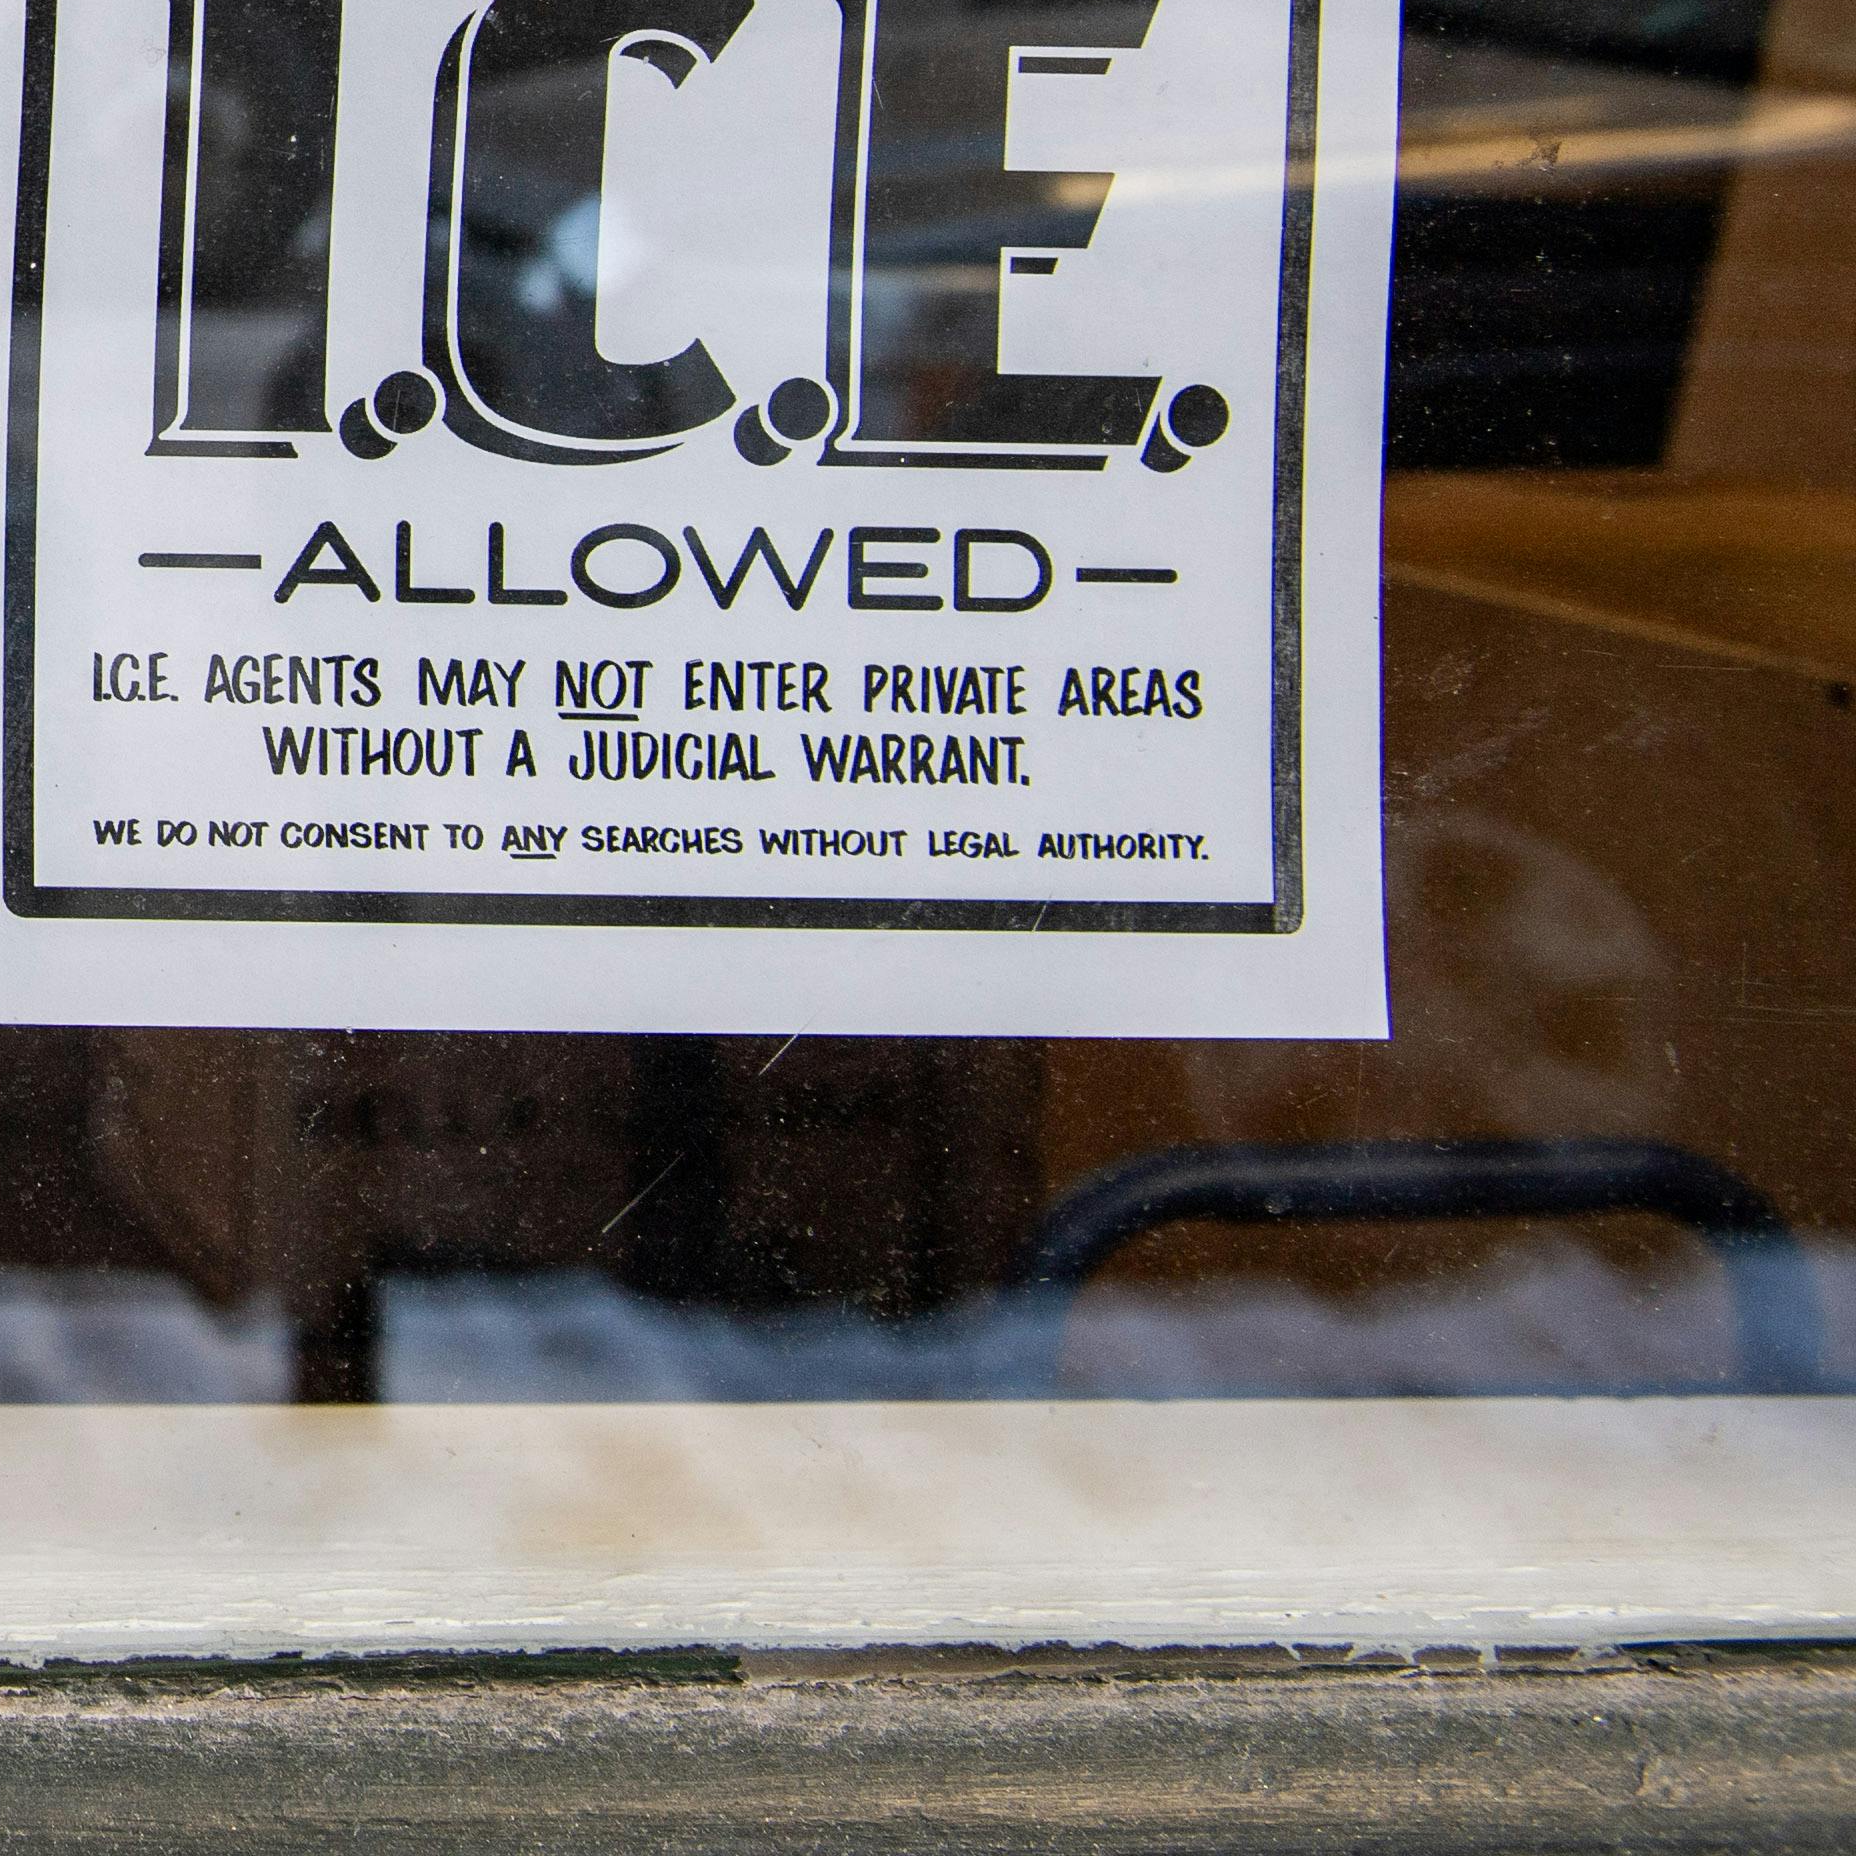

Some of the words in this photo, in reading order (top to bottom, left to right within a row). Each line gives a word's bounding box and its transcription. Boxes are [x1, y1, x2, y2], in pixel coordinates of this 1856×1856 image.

[93, 652, 178, 701] I.C.E.
[205, 654, 381, 707] AGENTS
[419, 657, 525, 707] MAY
[556, 660, 653, 709] NOT
[685, 660, 832, 713] ENTER
[864, 664, 1026, 715] PRIVATE
[1058, 667, 1202, 719] AREAS
[263, 727, 483, 776] WITHOUT
[506, 730, 536, 776] A
[569, 731, 775, 781] JUDICIAL
[801, 734, 1029, 785] WARRANT.
[93, 819, 141, 845] WE
[158, 820, 197, 847] DO
[209, 821, 268, 847] NOT
[281, 822, 429, 850] CONSENT
[444, 824, 483, 850] TO
[502, 825, 567, 851] ANY
[581, 826, 743, 854] SEARCHES
[759, 829, 907, 856] WITHOUT
[929, 830, 1019, 858] LEGAL
[1038, 833, 1208, 860] AUTHORITY.
